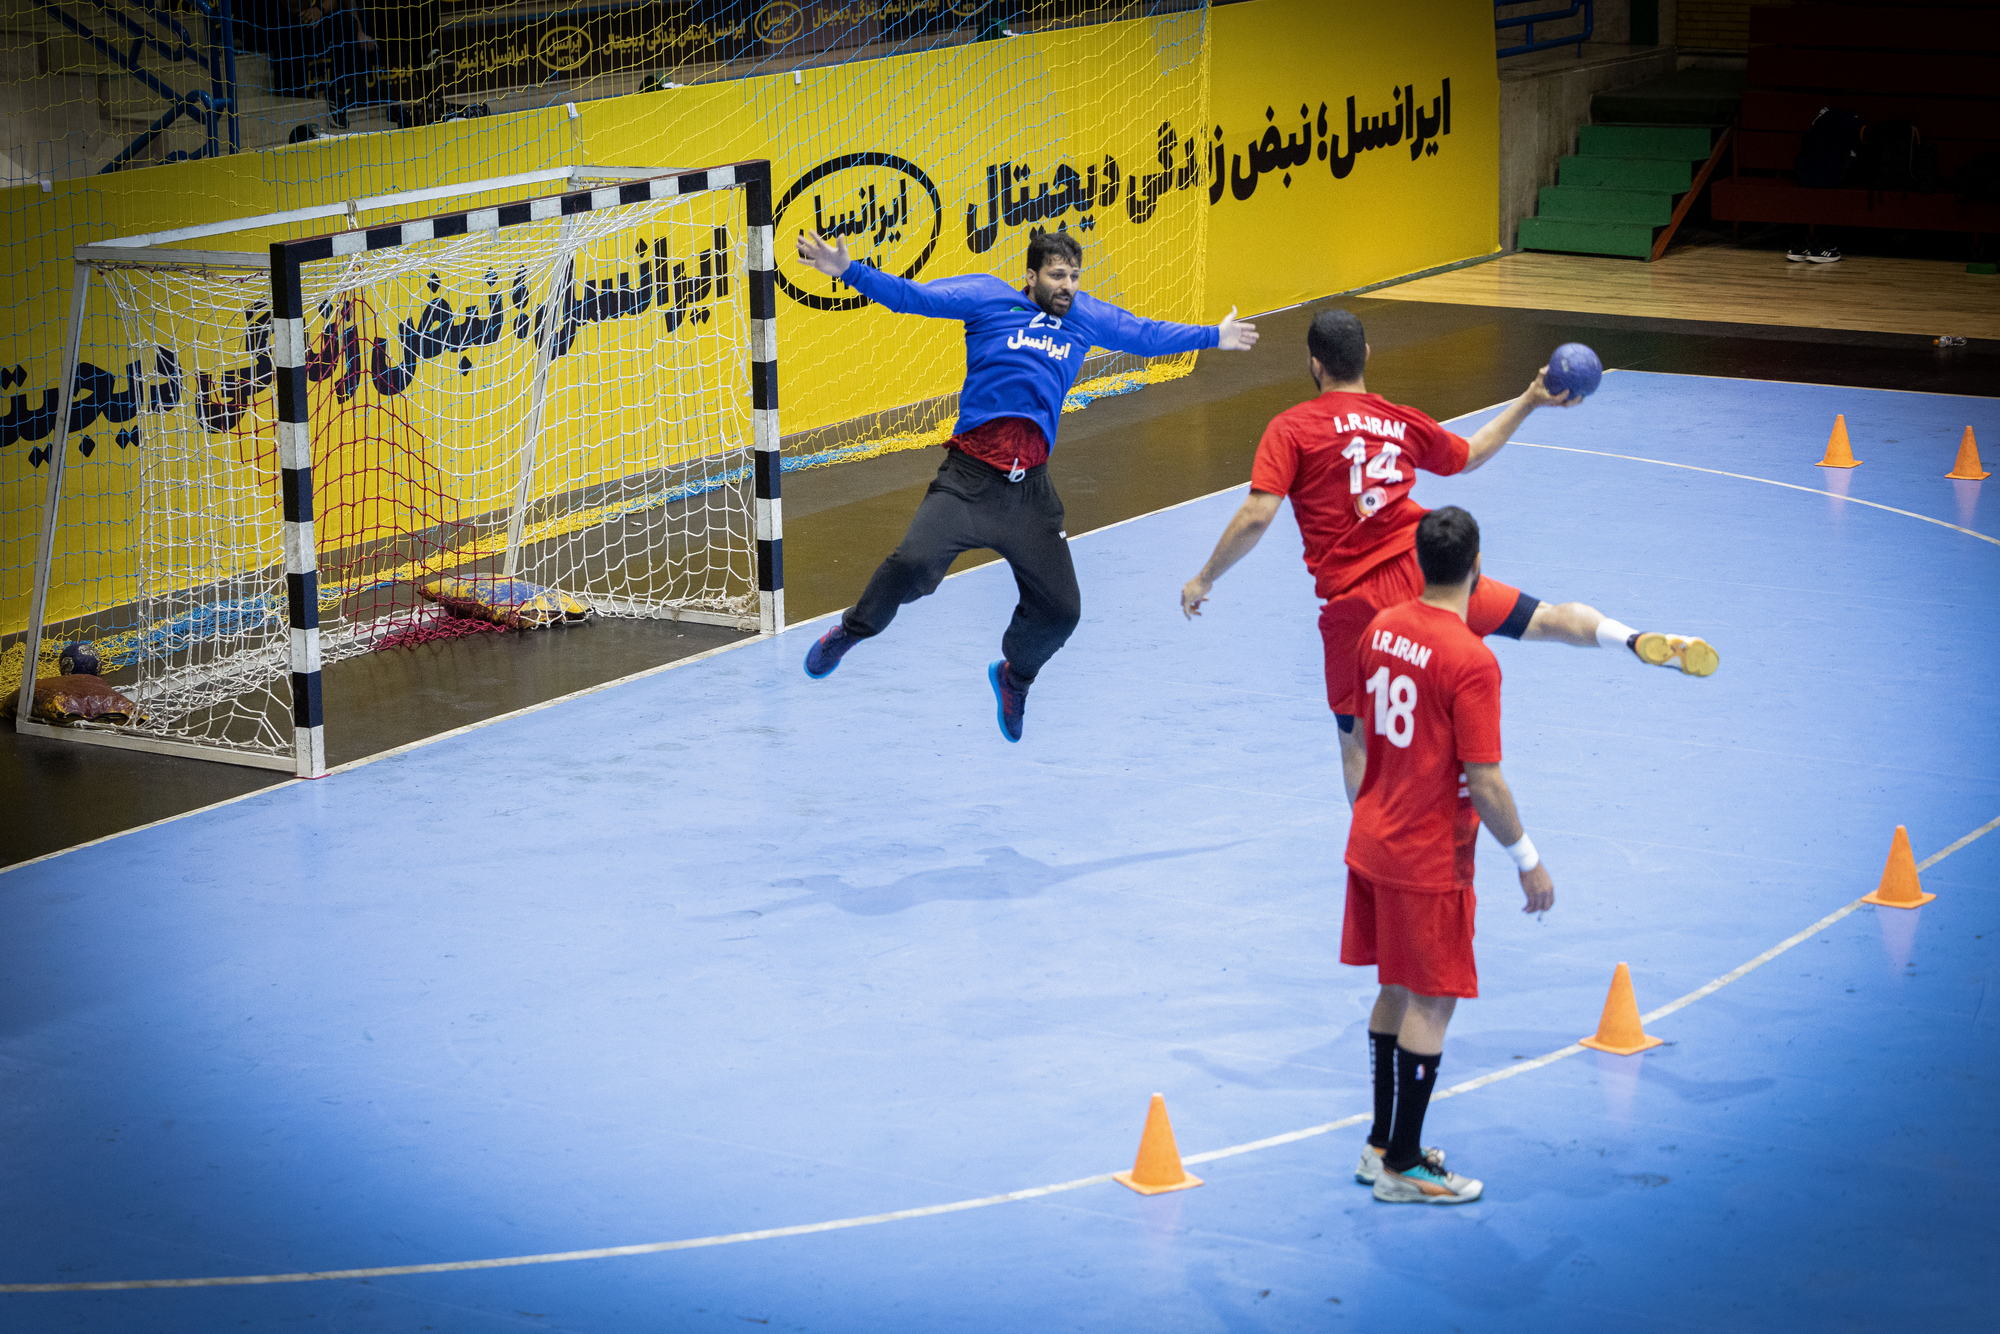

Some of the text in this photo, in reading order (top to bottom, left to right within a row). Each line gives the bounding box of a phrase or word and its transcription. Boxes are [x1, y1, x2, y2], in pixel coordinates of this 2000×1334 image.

[1231, 105, 1312, 201] نبض
[966, 153, 1120, 254] دیجیتال
[371, 266, 503, 396] نبض
[1007, 329, 1071, 360] ایرانسل
[0, 345, 182, 468] دیجیت
[1341, 436, 1403, 494] 14
[1366, 666, 1417, 748] 18
